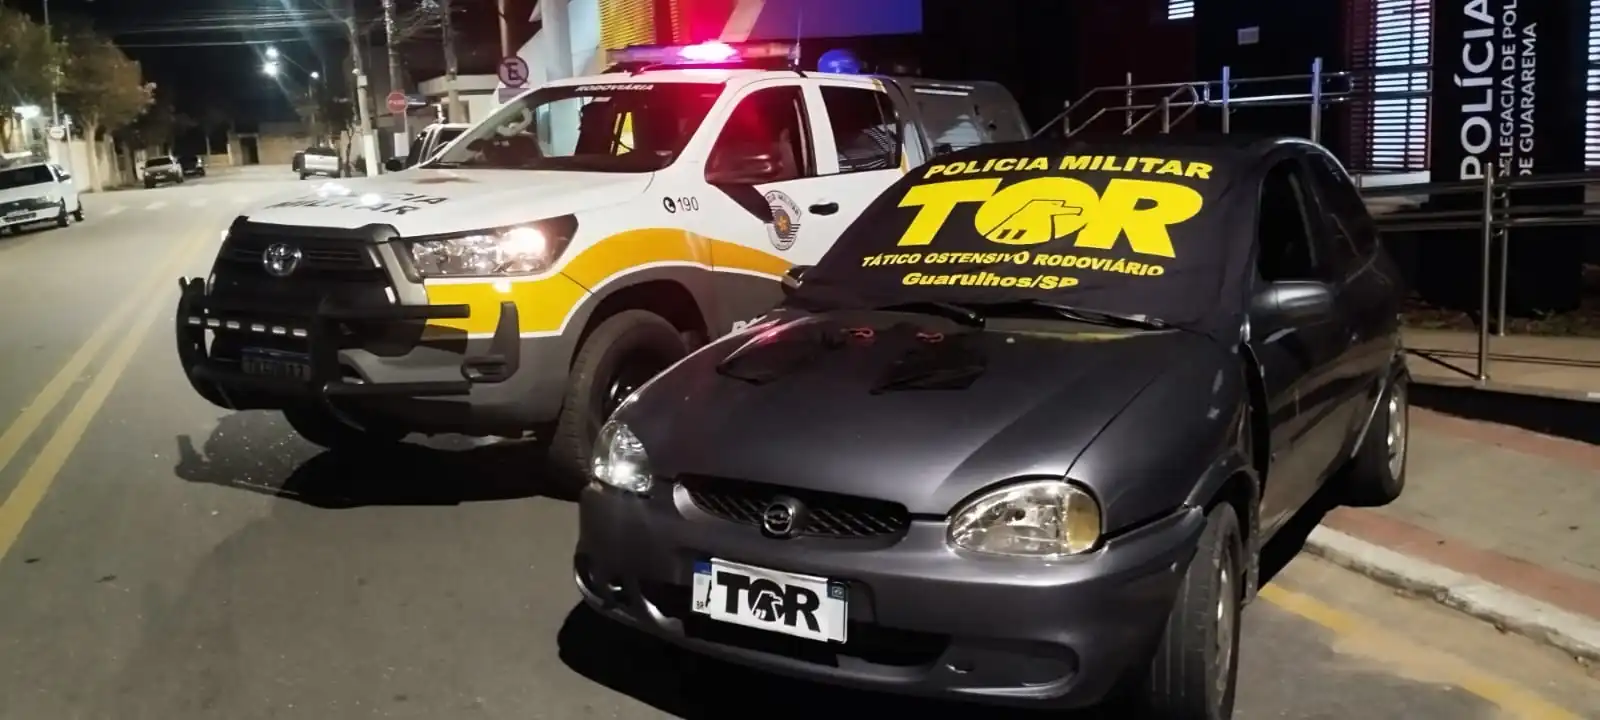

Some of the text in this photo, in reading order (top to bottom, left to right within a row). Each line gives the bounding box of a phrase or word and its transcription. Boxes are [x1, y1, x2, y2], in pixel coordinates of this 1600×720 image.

[1502, 44, 1516, 71] DE
[1453, 0, 1495, 180] POLÍCIA
[1519, 22, 1538, 153] GUARAREMA
[924, 155, 1214, 180] POLICIA MILITAR
[676, 195, 700, 211] 190
[896, 176, 1203, 258] TOR
[861, 250, 1165, 276] TÁTICO OSTENSIVO RODOVIÁRIO
[901, 272, 1079, 289] Guarulhos/SP
[716, 571, 821, 632] TOR
